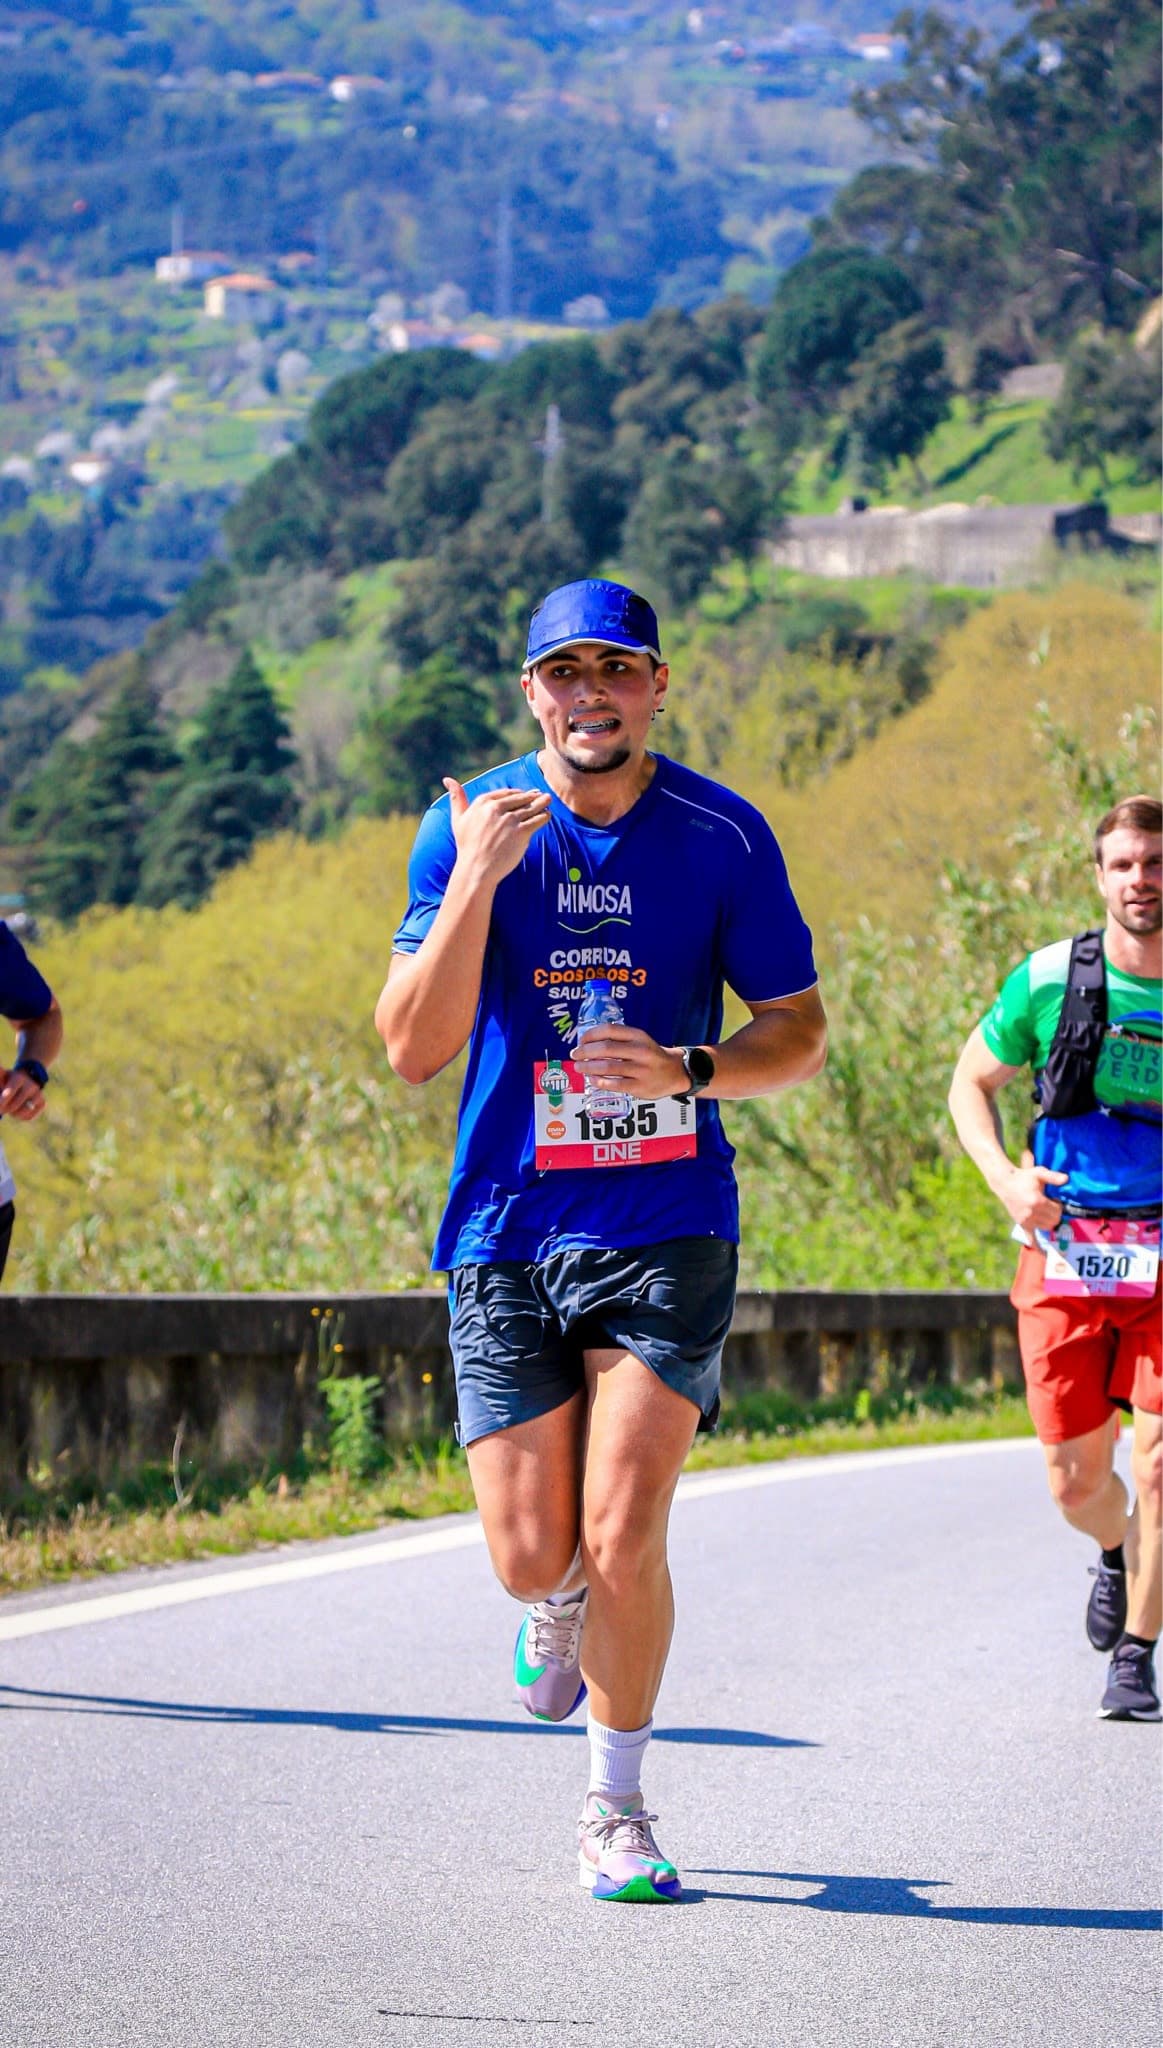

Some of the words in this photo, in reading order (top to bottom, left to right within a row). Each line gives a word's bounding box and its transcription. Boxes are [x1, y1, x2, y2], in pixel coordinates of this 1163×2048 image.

[558, 882, 633, 915] MIMOSA
[549, 947, 632, 968] CORRIDA
[575, 1103, 658, 1141] 1535
[593, 1141, 641, 1162] ONE
[1076, 1255, 1131, 1278] 1520
